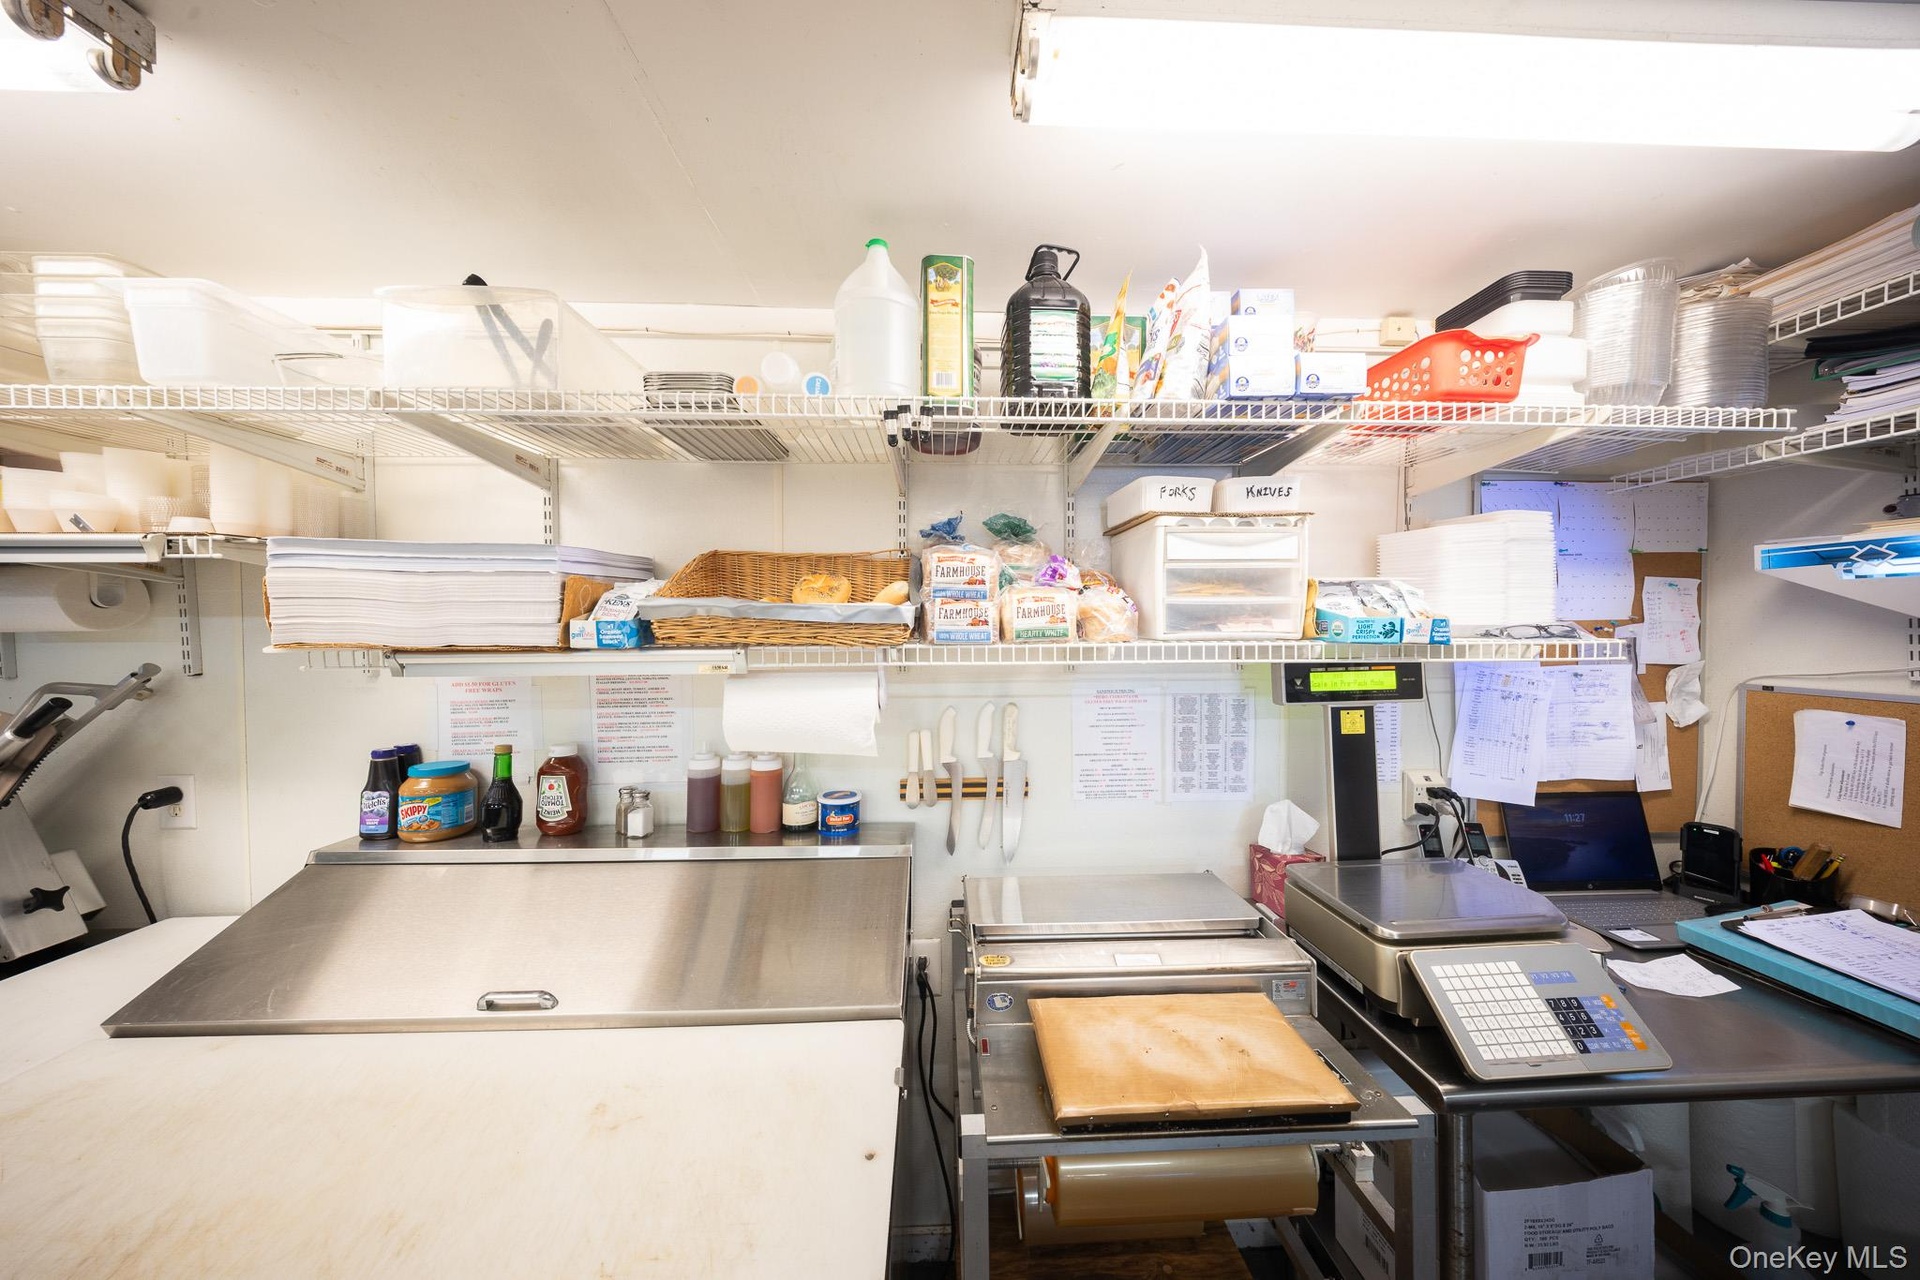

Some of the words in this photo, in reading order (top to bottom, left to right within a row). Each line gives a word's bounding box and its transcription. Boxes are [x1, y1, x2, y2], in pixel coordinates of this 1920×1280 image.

[1160, 484, 1196, 501] FORKS
[1246, 485, 1292, 499] KNIVES
[935, 565, 986, 578] FARMHOUSE
[946, 590, 964, 598] WHOLE
[965, 590, 985, 598] WHEAT
[938, 607, 989, 620] FARMHOUSE
[1016, 604, 1066, 619] FARMHOUSE
[950, 632, 968, 640] WHOLE
[969, 631, 989, 640] WHEAT
[1020, 630, 1043, 638] HEARTY
[401, 805, 428, 820] SKIPPY
[1564, 813, 1586, 822] 11:27
[1560, 1000, 1567, 1008] 8
[1571, 999, 1578, 1007] 9
[1579, 1027, 1586, 1035] 2
[1590, 1026, 1597, 1034] 3
[1577, 1042, 1584, 1050] 0
